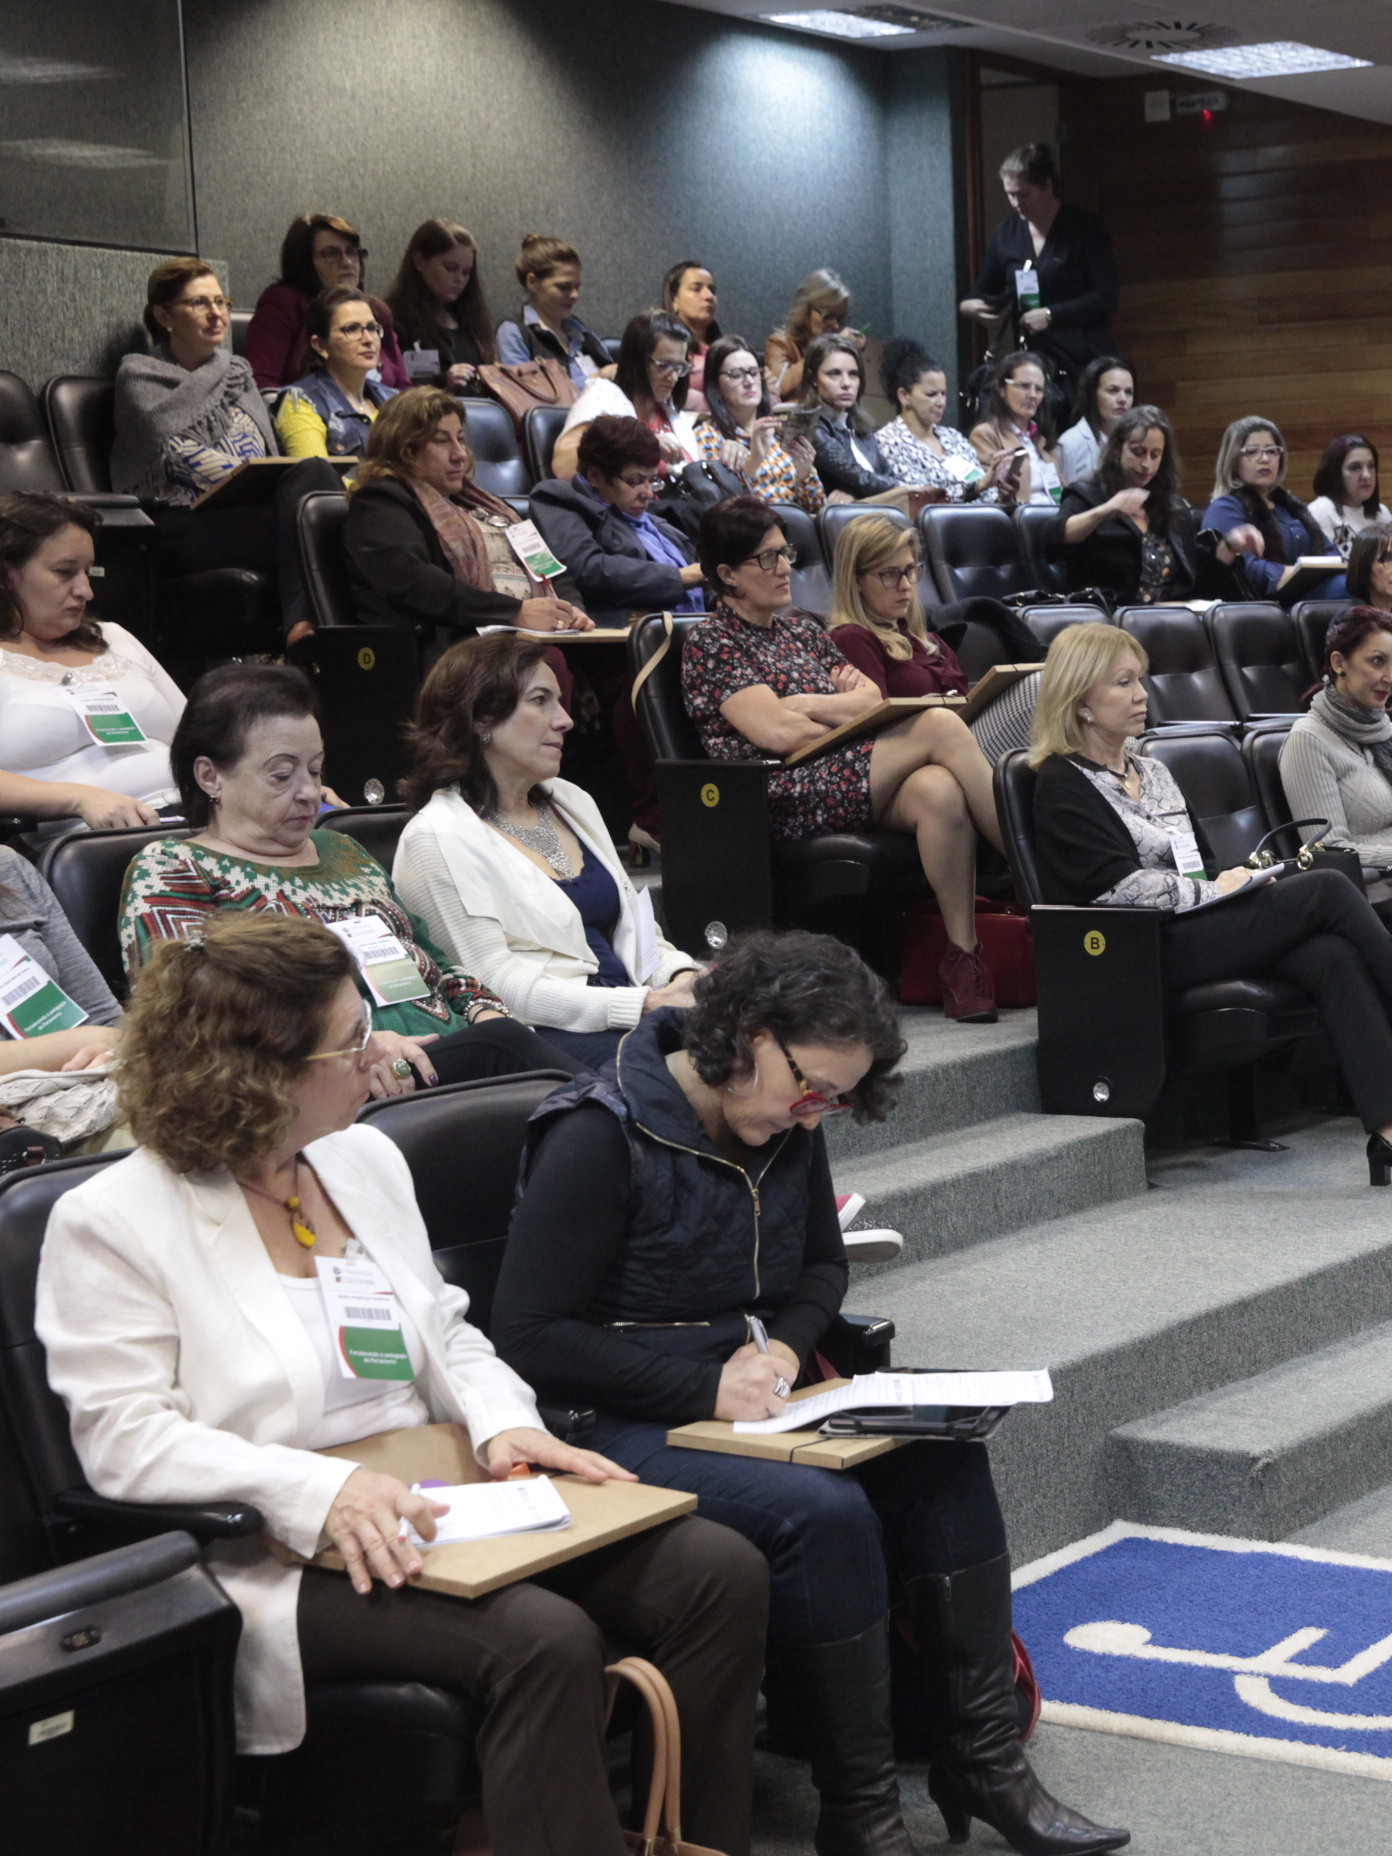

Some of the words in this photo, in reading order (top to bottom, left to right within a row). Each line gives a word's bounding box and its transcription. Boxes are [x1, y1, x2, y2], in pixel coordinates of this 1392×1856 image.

[363, 653, 371, 665] D
[706, 789, 715, 802] C
[1090, 937, 1100, 950] B
